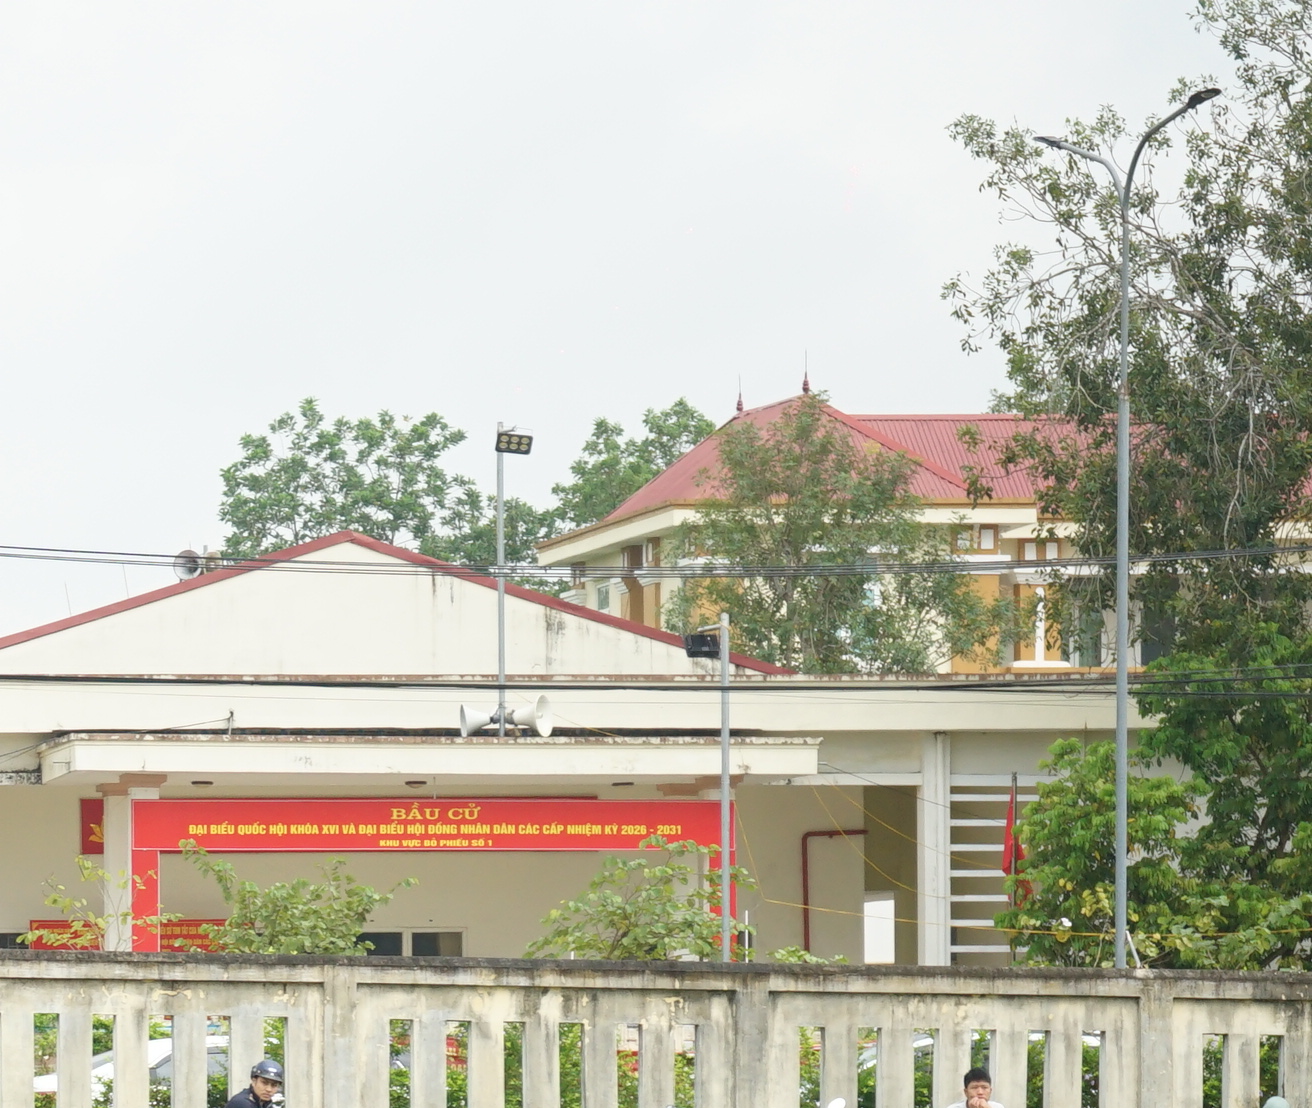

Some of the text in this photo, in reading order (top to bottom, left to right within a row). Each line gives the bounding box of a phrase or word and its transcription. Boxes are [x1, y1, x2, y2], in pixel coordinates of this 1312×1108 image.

[390, 802, 482, 820] BẦU CỬ
[188, 822, 207, 836] ĐẠI
[209, 821, 235, 835] BIỂU
[237, 821, 267, 836] QUỐC
[269, 822, 288, 837] HỘI
[290, 821, 320, 835] KHÓA
[322, 823, 339, 835] XVI
[341, 821, 356, 835] VÀ
[358, 823, 377, 837] ĐẠI
[379, 821, 404, 836] BIỂU
[407, 823, 426, 837] HỘI
[428, 821, 458, 835] ĐỒNG
[460, 822, 490, 835] NHÂN
[493, 821, 516, 835] DÂN
[518, 821, 541, 835] CÁC
[543, 821, 565, 835] CẤP
[567, 822, 602, 837] NHIỆM
[605, 821, 619, 835] KỲ
[621, 824, 647, 835] 2026
[656, 824, 682, 835] 2031
[379, 839, 400, 847] KHU
[402, 839, 422, 848] VỰC
[424, 837, 438, 847] BỎ
[439, 837, 469, 847] PHIẾU
[471, 837, 486, 847] SỐ
